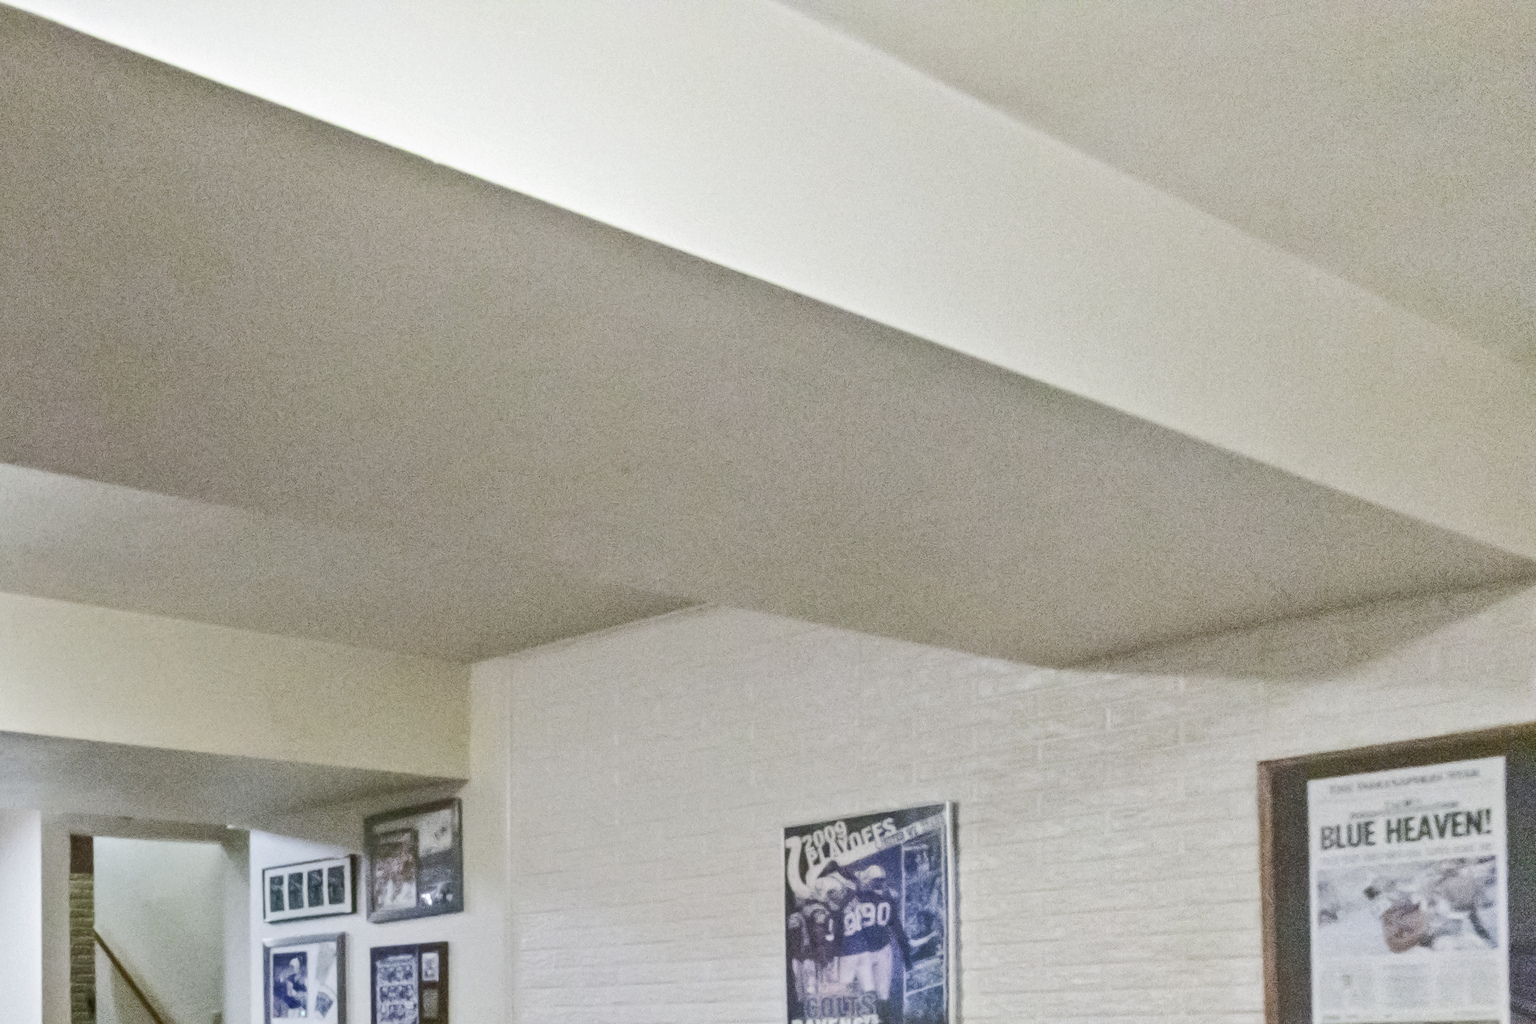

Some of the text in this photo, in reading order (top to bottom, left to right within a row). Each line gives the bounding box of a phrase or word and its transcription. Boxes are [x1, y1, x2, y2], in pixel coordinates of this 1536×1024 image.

[800, 820, 847, 849] 2009
[805, 817, 898, 865] PLAYOFFS
[1320, 820, 1376, 850] BLUE
[1385, 808, 1492, 844] HEAVEN!
